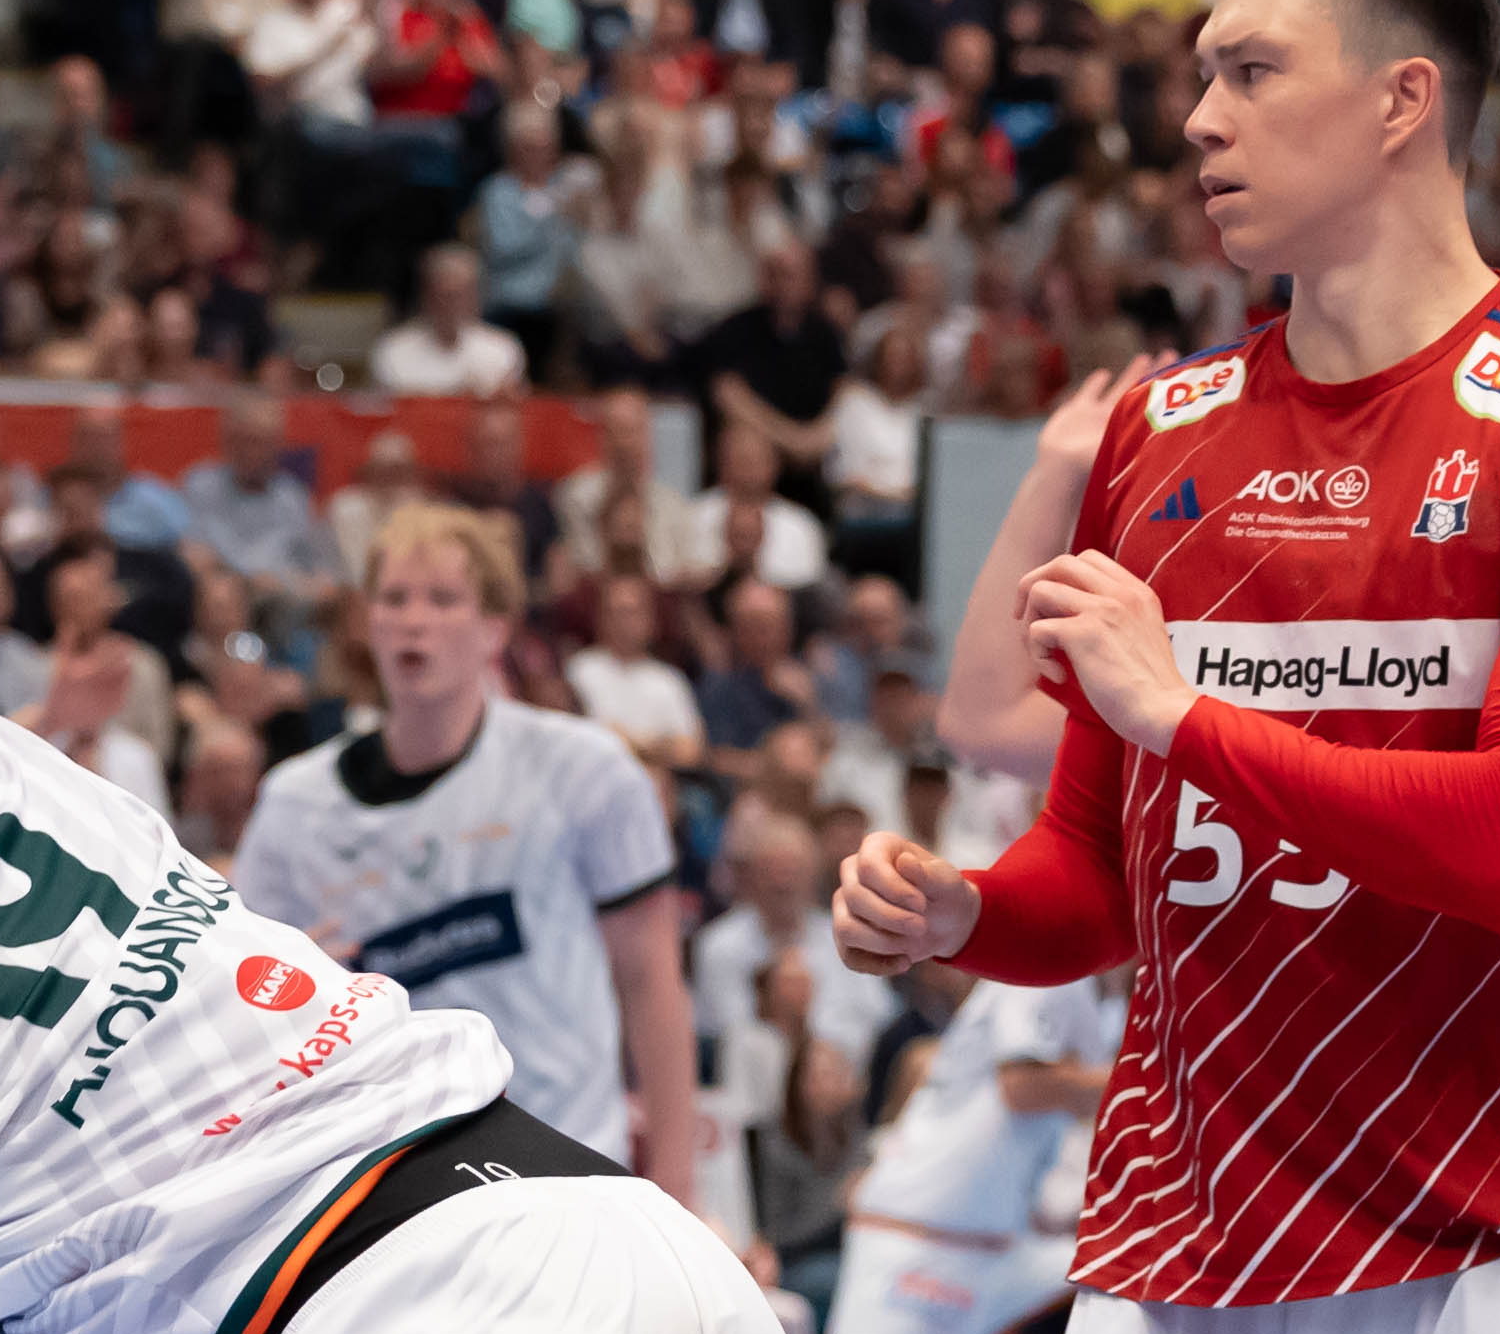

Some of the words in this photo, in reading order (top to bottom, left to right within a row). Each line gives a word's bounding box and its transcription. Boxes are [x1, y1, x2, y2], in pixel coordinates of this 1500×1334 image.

[1236, 469, 1325, 504] AOK
[1196, 645, 1450, 698] Hapag-Lloyd
[252, 962, 295, 1005] KAPS
